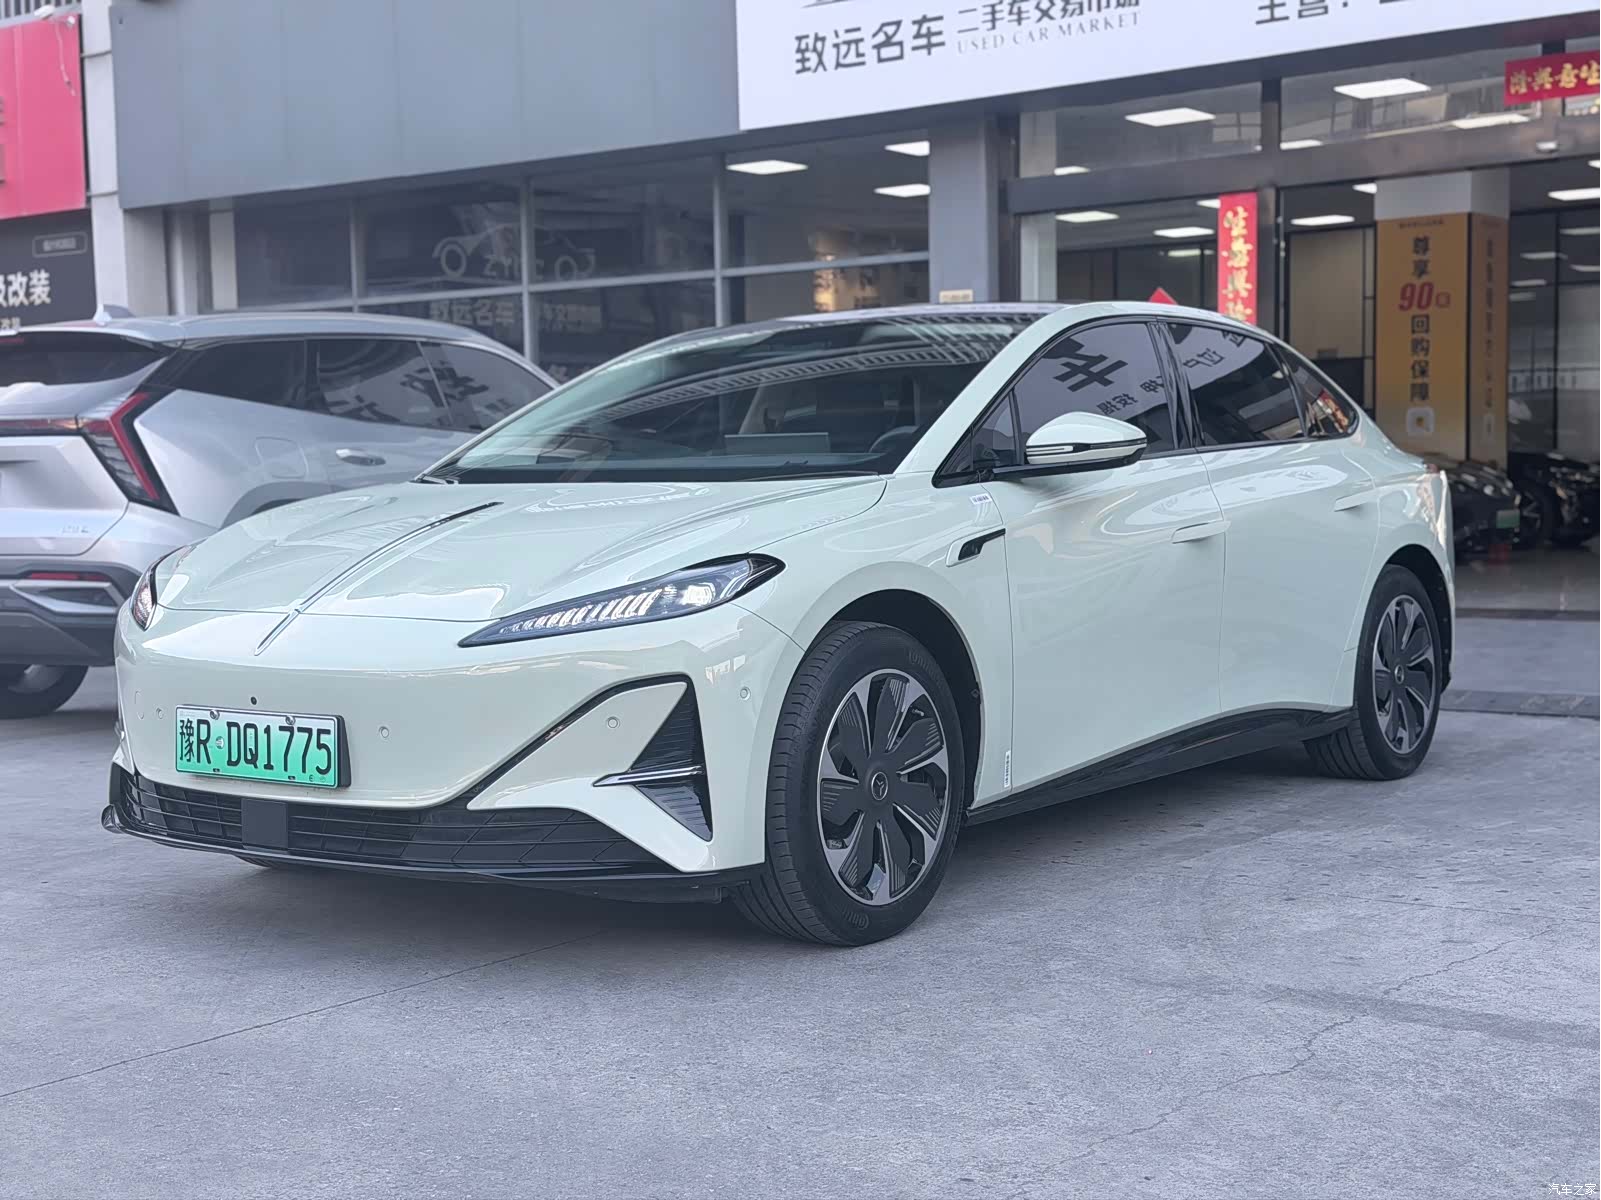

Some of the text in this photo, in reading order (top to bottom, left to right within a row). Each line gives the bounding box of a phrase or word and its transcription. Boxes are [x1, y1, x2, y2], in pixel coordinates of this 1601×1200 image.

[957, 0, 1141, 34] 二手车交易
[957, 12, 1141, 55] USED CAR MARKET
[794, 14, 946, 75] 致远名车
[1398, 282, 1435, 312] 90
